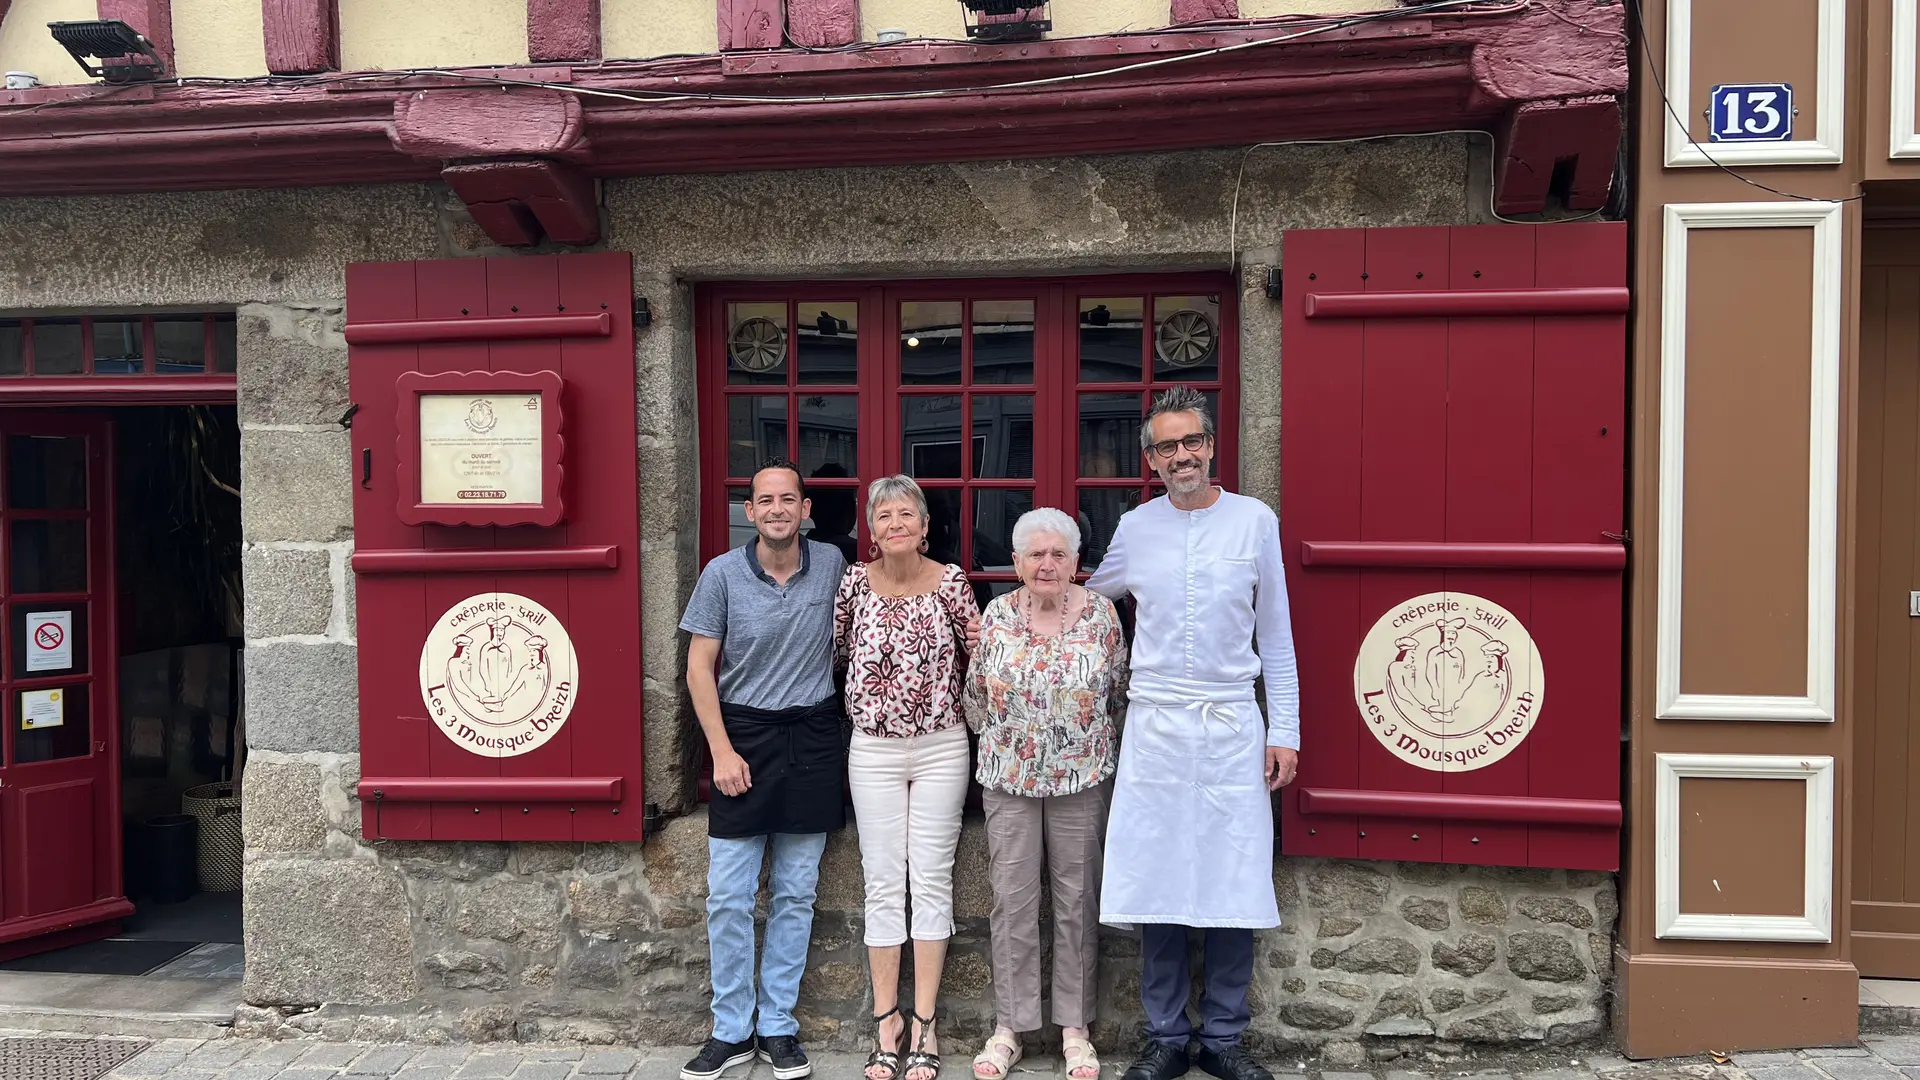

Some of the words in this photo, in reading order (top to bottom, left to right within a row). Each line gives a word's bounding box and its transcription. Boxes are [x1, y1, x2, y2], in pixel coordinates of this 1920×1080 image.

[1721, 91, 1781, 134] 13
[427, 683, 447, 717] Les
[445, 715, 458, 728] 3
[1363, 688, 1385, 725] Les
[1383, 724, 1398, 737] 3
